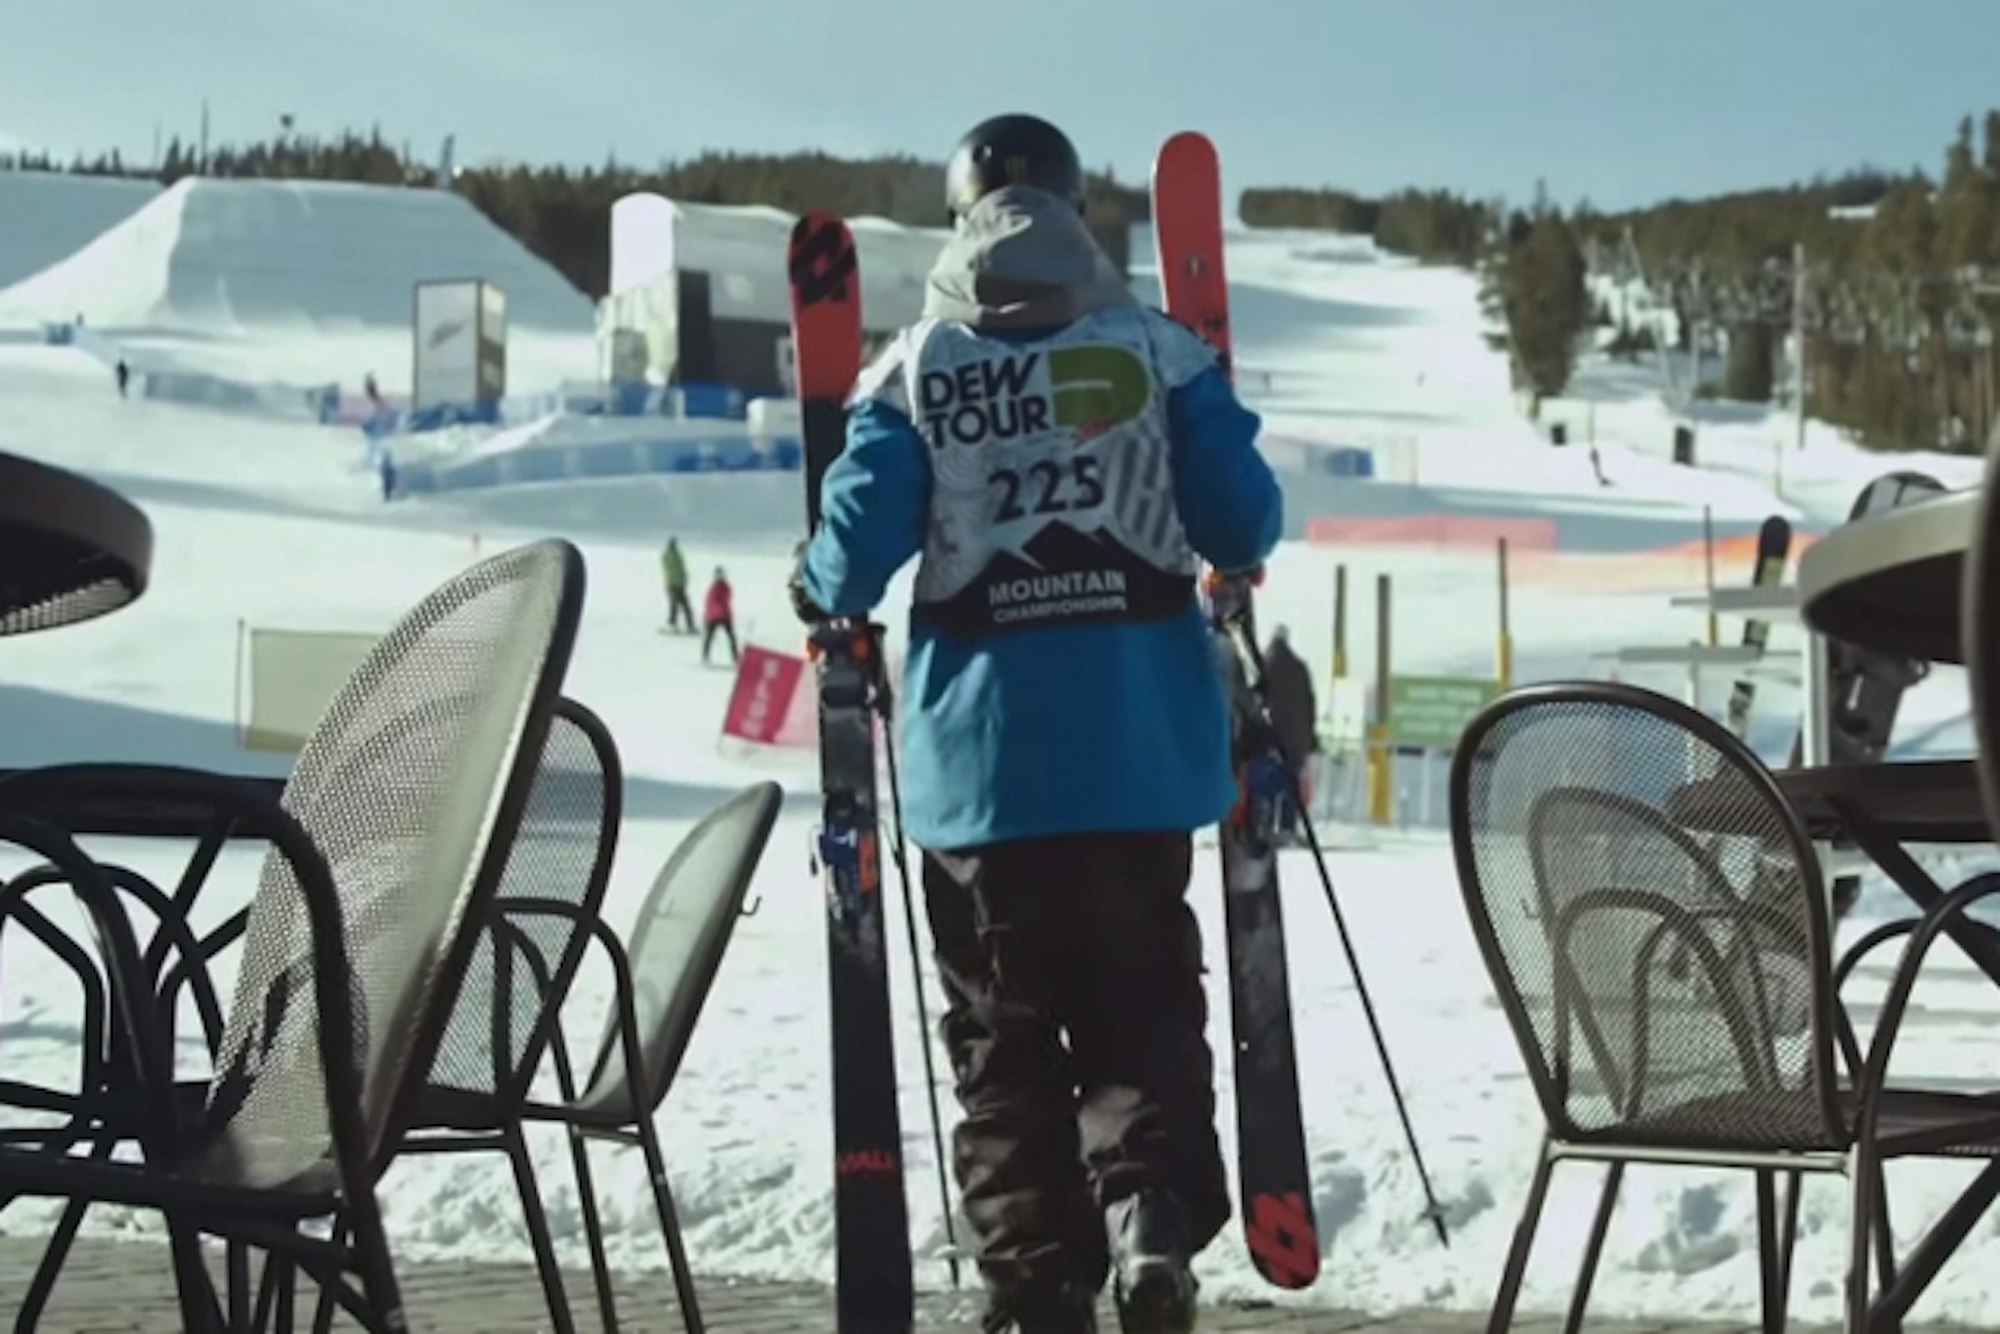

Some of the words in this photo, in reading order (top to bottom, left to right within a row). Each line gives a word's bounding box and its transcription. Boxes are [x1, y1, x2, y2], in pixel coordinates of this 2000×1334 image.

[922, 353, 1039, 409] DEW
[926, 397, 1048, 448] TOUR
[988, 455, 1105, 524] 225
[989, 570, 1126, 604] MOUNTAIN
